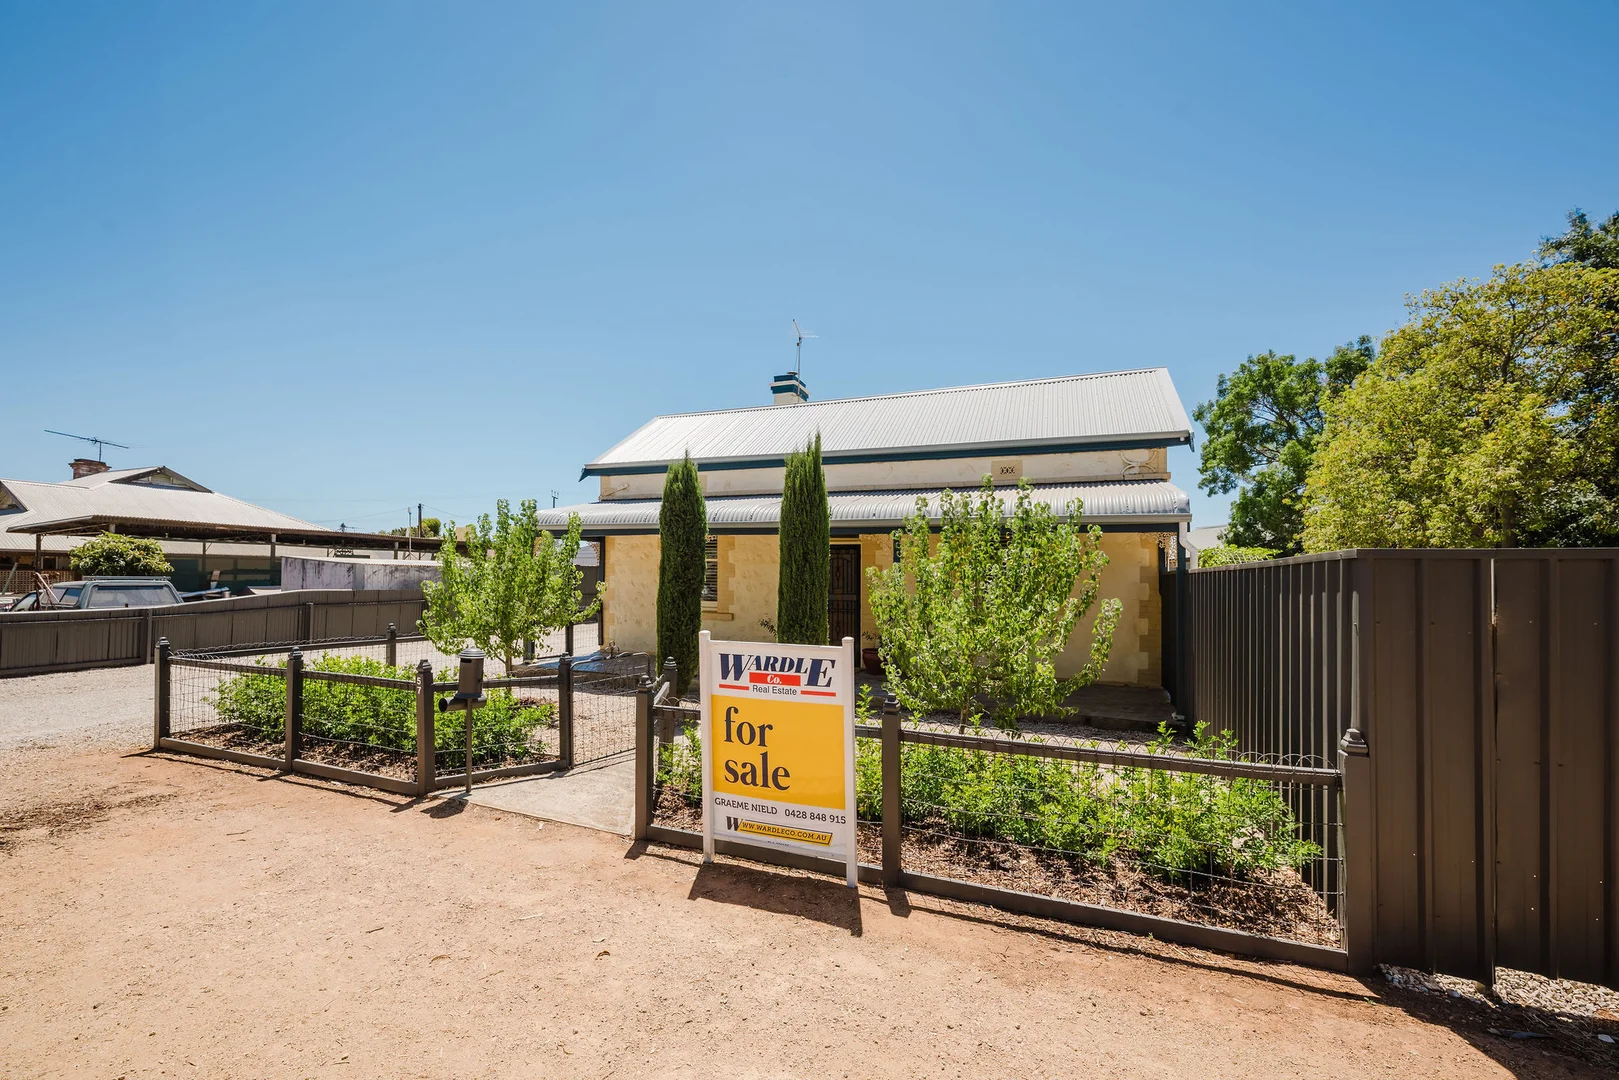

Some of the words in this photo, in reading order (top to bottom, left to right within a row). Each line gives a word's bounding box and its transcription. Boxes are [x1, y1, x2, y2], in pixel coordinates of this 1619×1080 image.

[718, 652, 836, 688] WARDLE
[766, 674, 783, 684] Co.
[752, 684, 770, 694] Real
[772, 686, 798, 696] Estate
[724, 706, 774, 747] for
[724, 751, 791, 791] sale
[714, 797, 750, 811] GRAEME
[751, 803, 778, 815] NIELD
[784, 808, 807, 819] 0428
[809, 812, 827, 822] 848
[829, 814, 847, 825] 915
